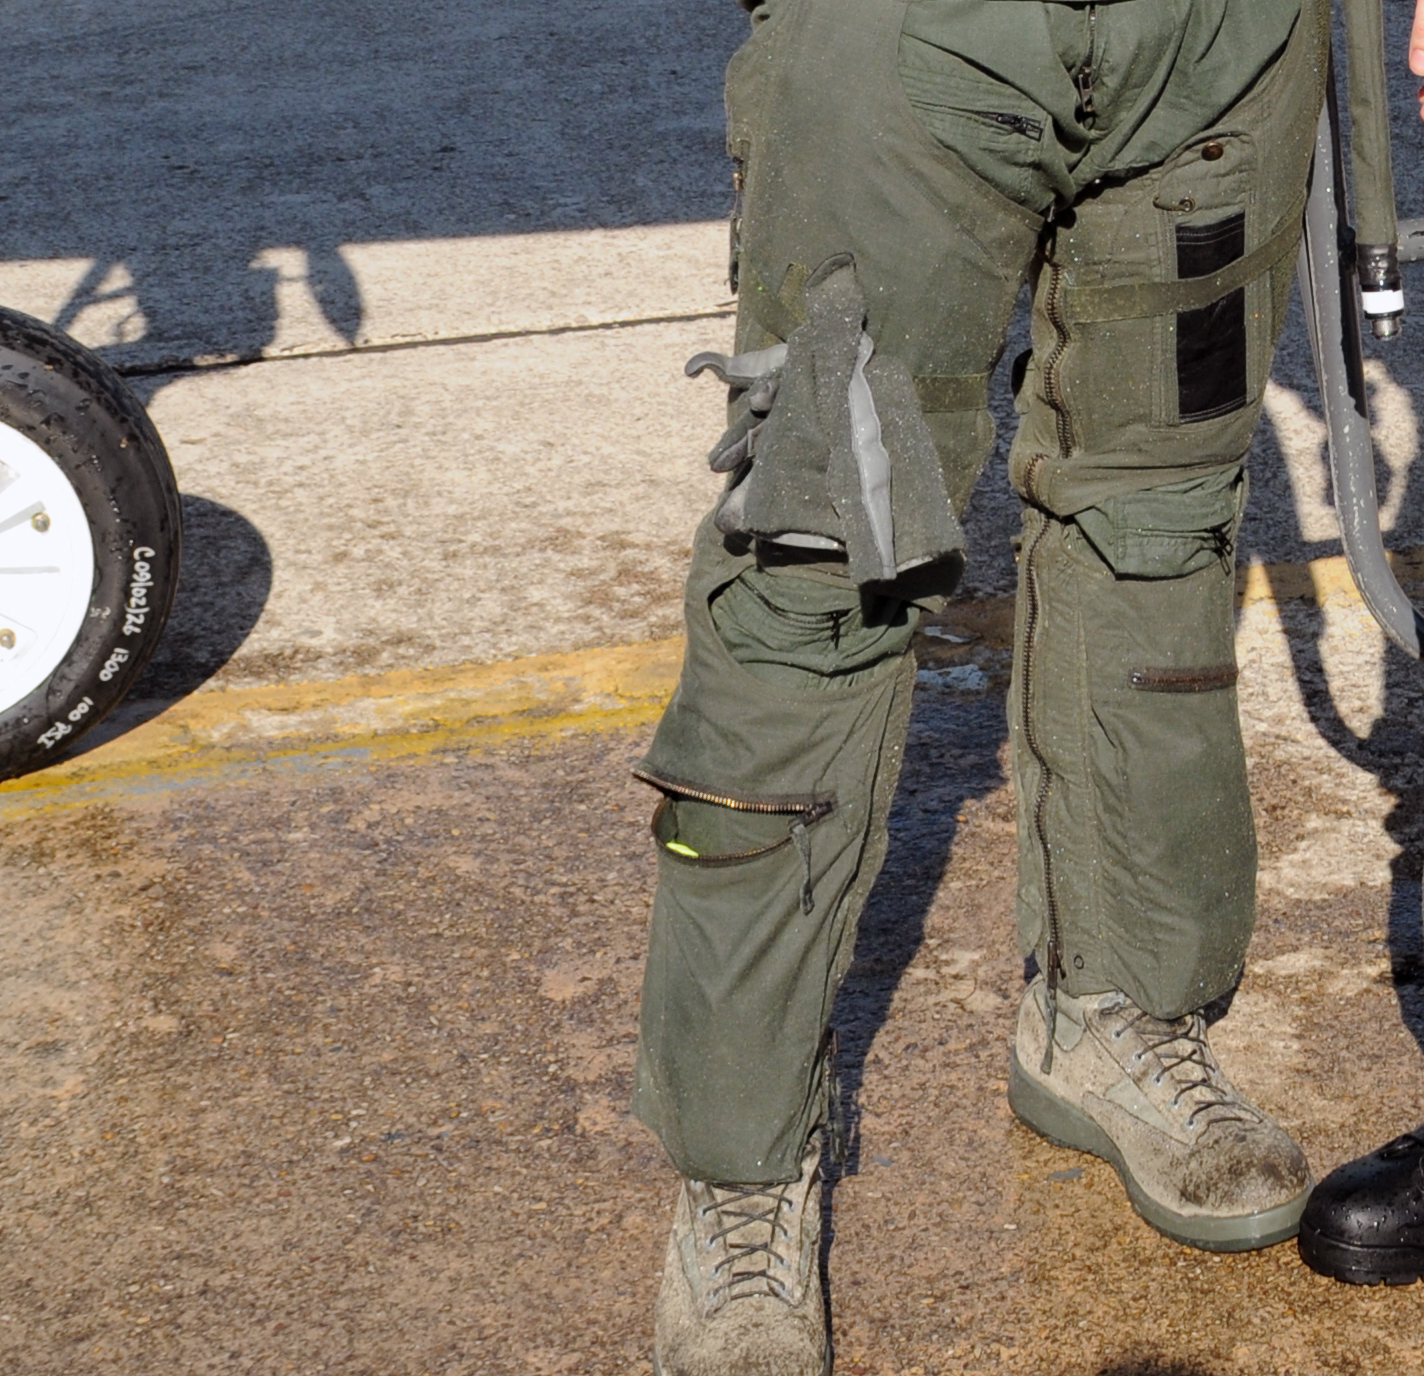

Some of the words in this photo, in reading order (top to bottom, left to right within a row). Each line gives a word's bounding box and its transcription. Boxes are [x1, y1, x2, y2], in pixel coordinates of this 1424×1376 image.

[99, 647, 130, 682] 1300
[68, 696, 94, 722] 100
[36, 721, 73, 749] PSI
